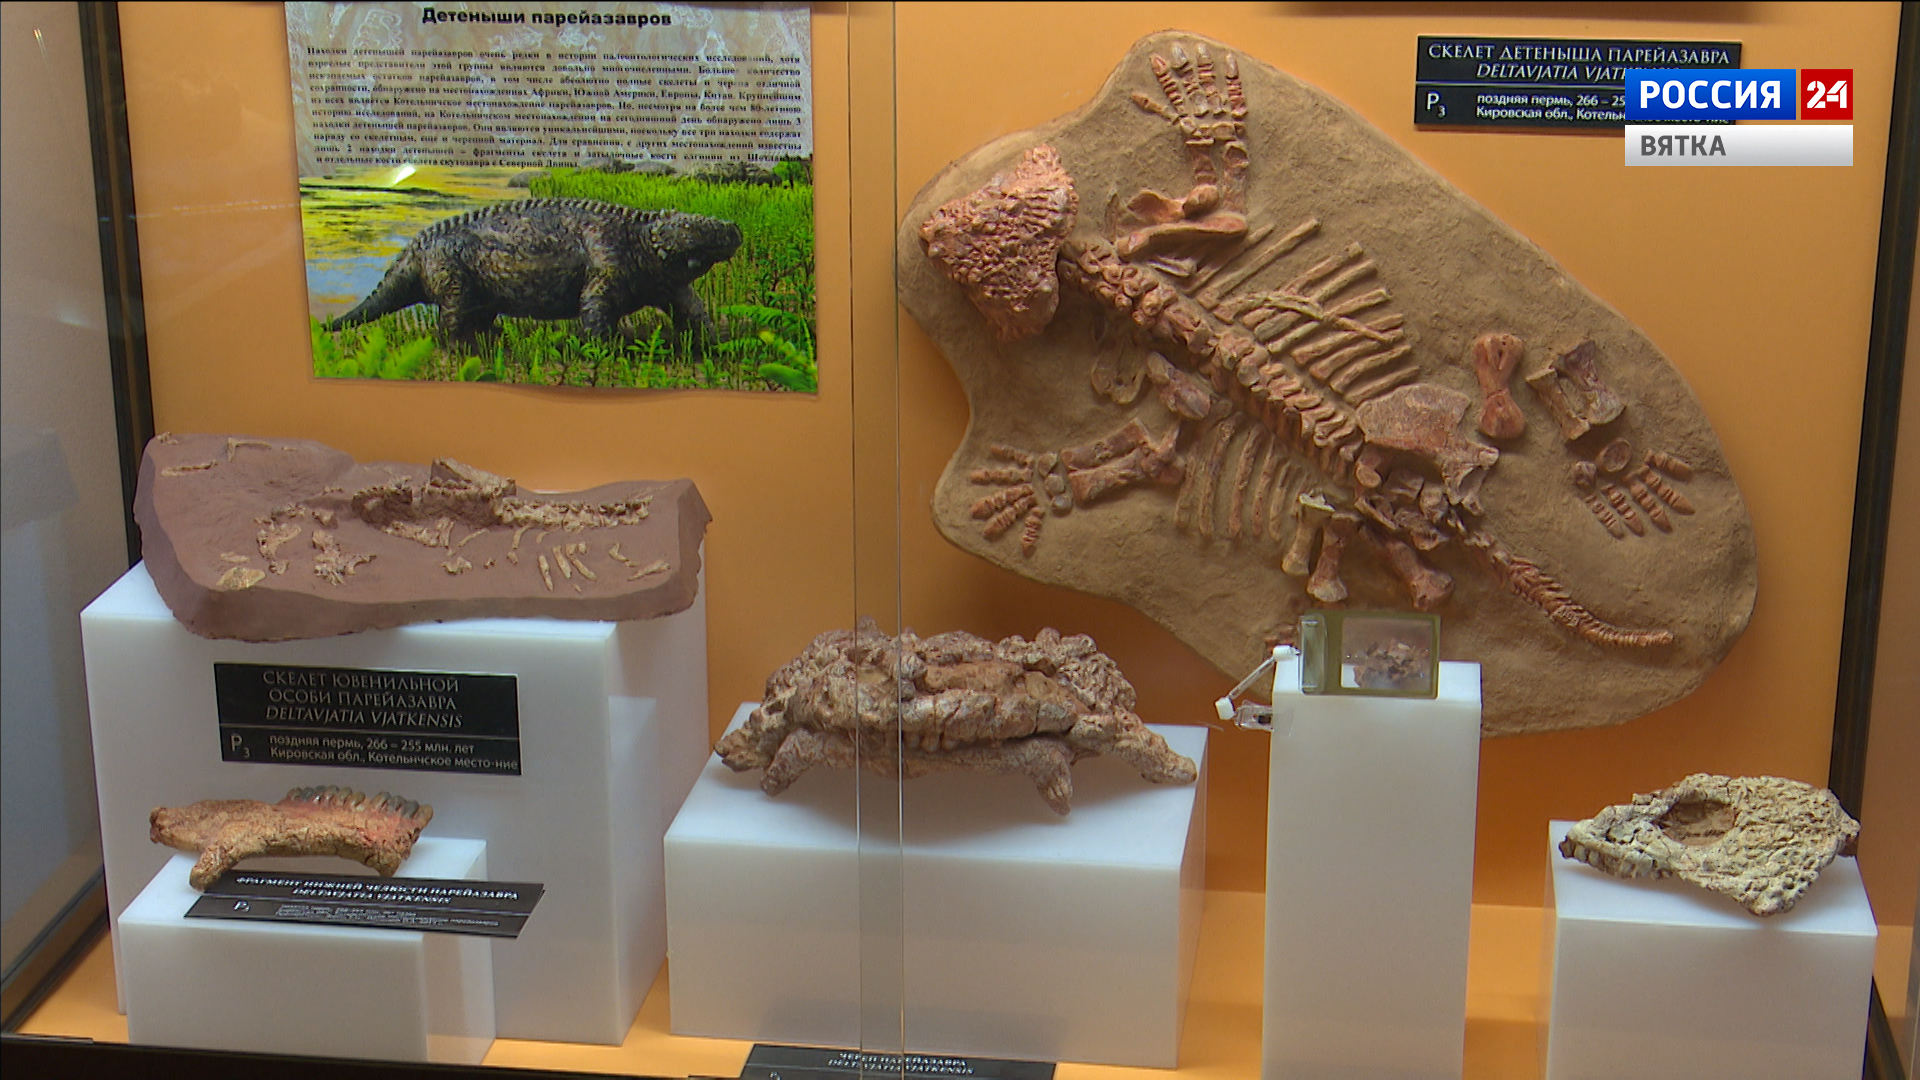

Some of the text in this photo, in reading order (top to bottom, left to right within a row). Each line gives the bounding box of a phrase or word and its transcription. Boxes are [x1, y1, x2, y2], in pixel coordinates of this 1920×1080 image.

[422, 7, 672, 28] Детеныши парейазавров
[1428, 43, 1730, 64] СКЕЛЕТ ДЕТЕНЫША ПАРЕЙАЗАВРА
[1476, 63, 1578, 82] DELTAVJATIA
[1477, 95, 1528, 106] поздняя
[1531, 95, 1573, 107] пермь,
[1576, 94, 1598, 106] 266
[1611, 95, 1625, 107] 25
[1476, 106, 1542, 120] Кировская
[263, 670, 459, 692] СКЕЛЕТ ЮВЕНИЛЬНОЙ
[269, 688, 457, 710] ОСОБИ ПАРЕЙАЗАВРА
[265, 705, 463, 728] DELTAVJATIA VJATKENSIS
[269, 735, 320, 747] поздняя
[322, 737, 364, 750] пермь,
[366, 739, 388, 751] 266
[400, 740, 422, 752] 255
[425, 743, 452, 754] млн.
[454, 743, 474, 754] лет
[270, 746, 335, 760] Кировская
